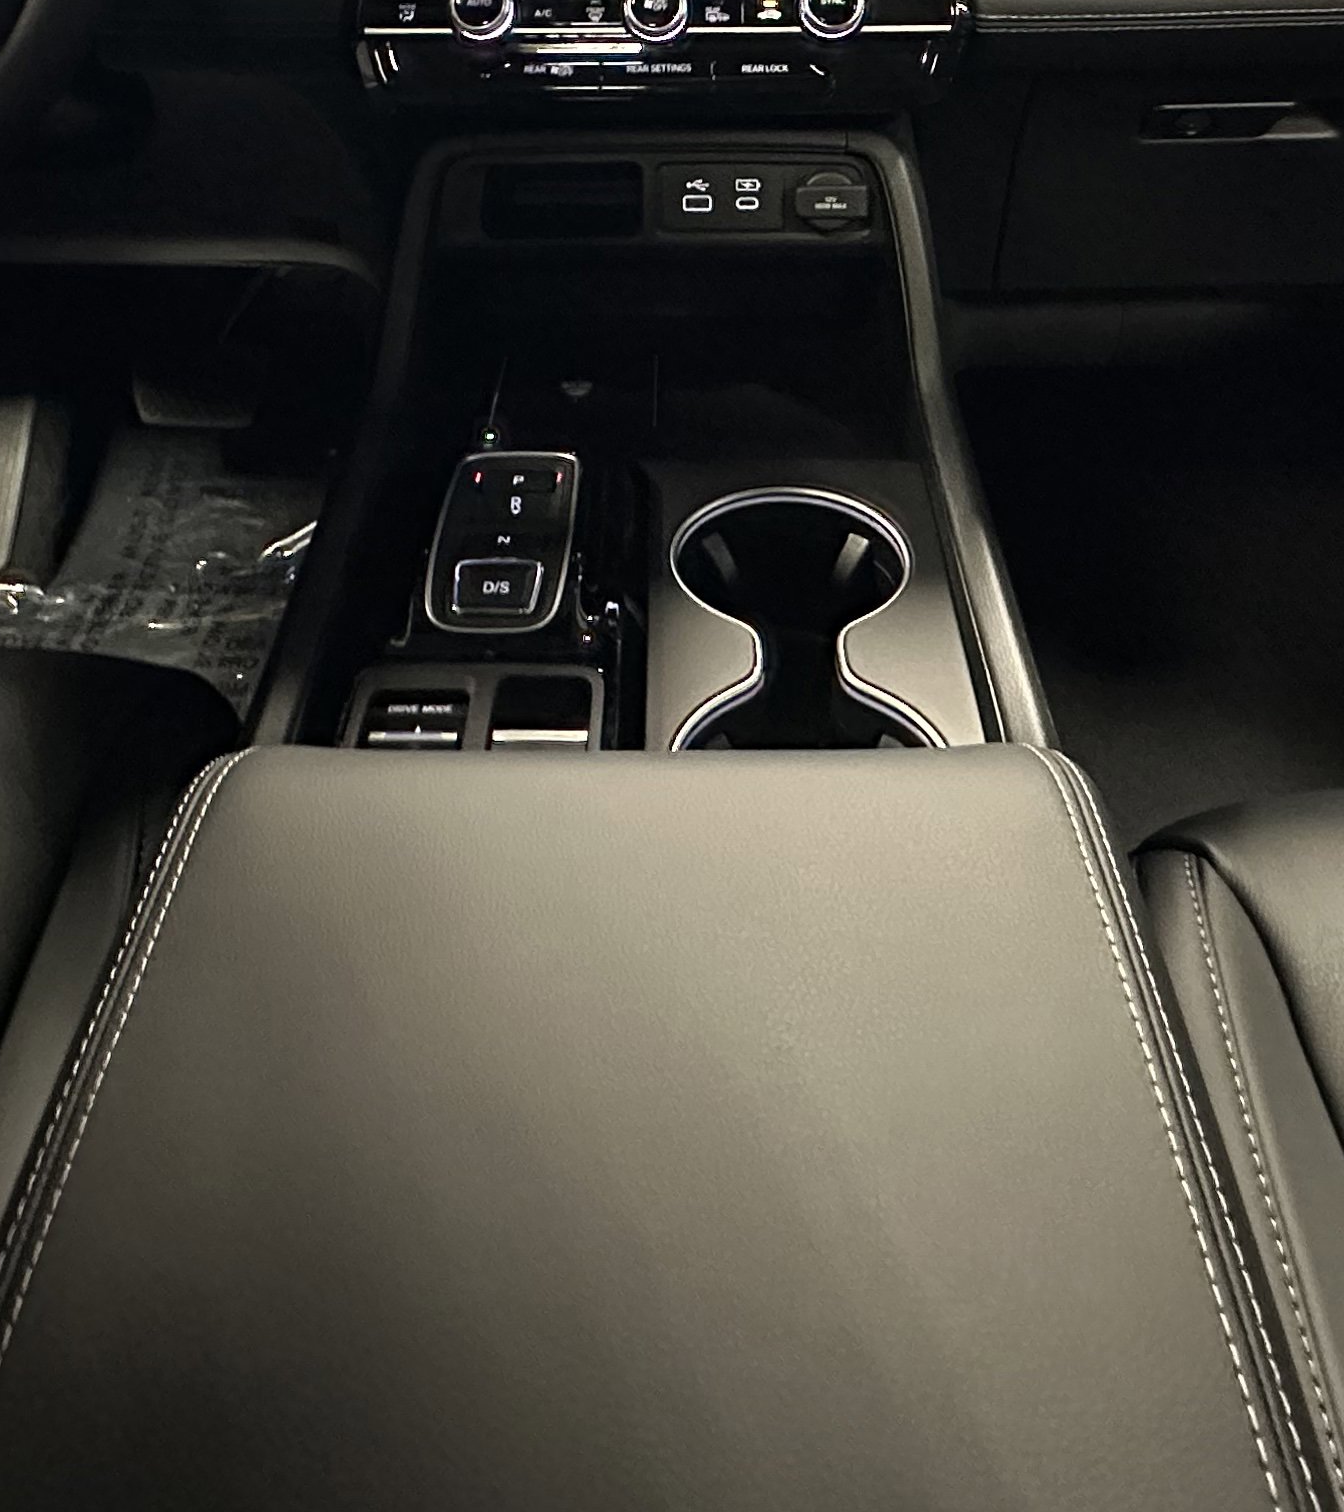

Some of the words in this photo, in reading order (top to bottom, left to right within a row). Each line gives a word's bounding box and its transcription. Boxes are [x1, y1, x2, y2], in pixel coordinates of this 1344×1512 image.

[534, 9, 553, 18] A/C
[626, 64, 650, 74] REAR
[650, 63, 693, 74] SETTINGS
[741, 64, 765, 74] REAR
[765, 63, 790, 73] LOCK
[512, 474, 525, 486] P
[497, 535, 511, 545] N
[482, 580, 511, 595] D/S
